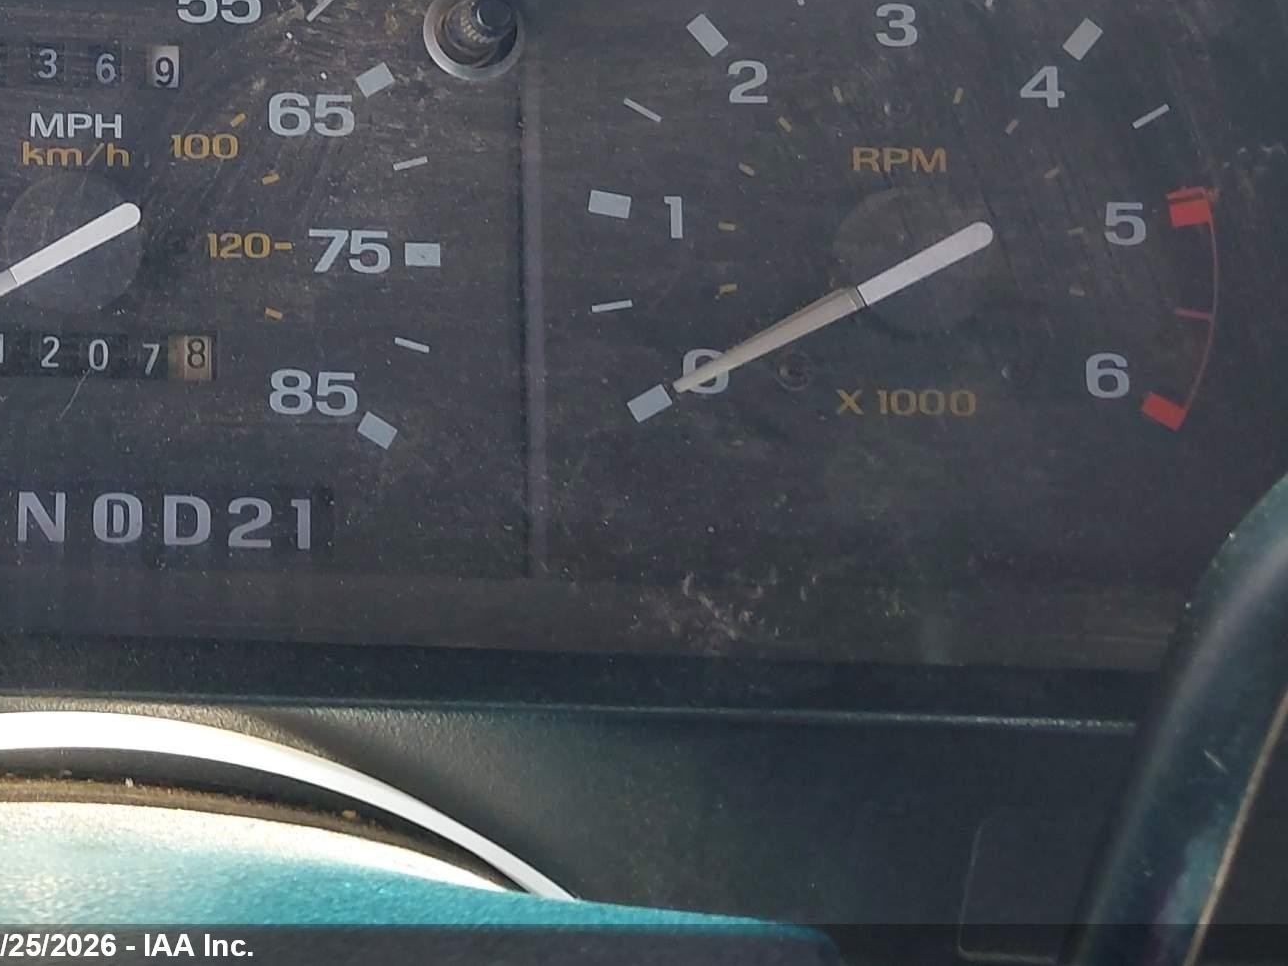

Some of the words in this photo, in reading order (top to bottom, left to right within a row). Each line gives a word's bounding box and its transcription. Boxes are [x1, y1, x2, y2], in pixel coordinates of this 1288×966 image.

[876, 3, 918, 47] 3
[727, 60, 768, 103] 2
[1020, 66, 1065, 108] 4
[29, 113, 122, 138] MPH
[268, 93, 355, 136] 65
[22, 141, 130, 167] km/h
[171, 133, 239, 160] 100
[852, 147, 946, 173] RPM
[664, 196, 683, 239] 1
[1104, 202, 1146, 245] 5
[208, 233, 270, 259] 120
[309, 229, 391, 274] 75
[269, 369, 358, 416] 85
[682, 349, 729, 394] 0
[1084, 353, 1130, 398] 6
[878, 389, 976, 416] 1000
